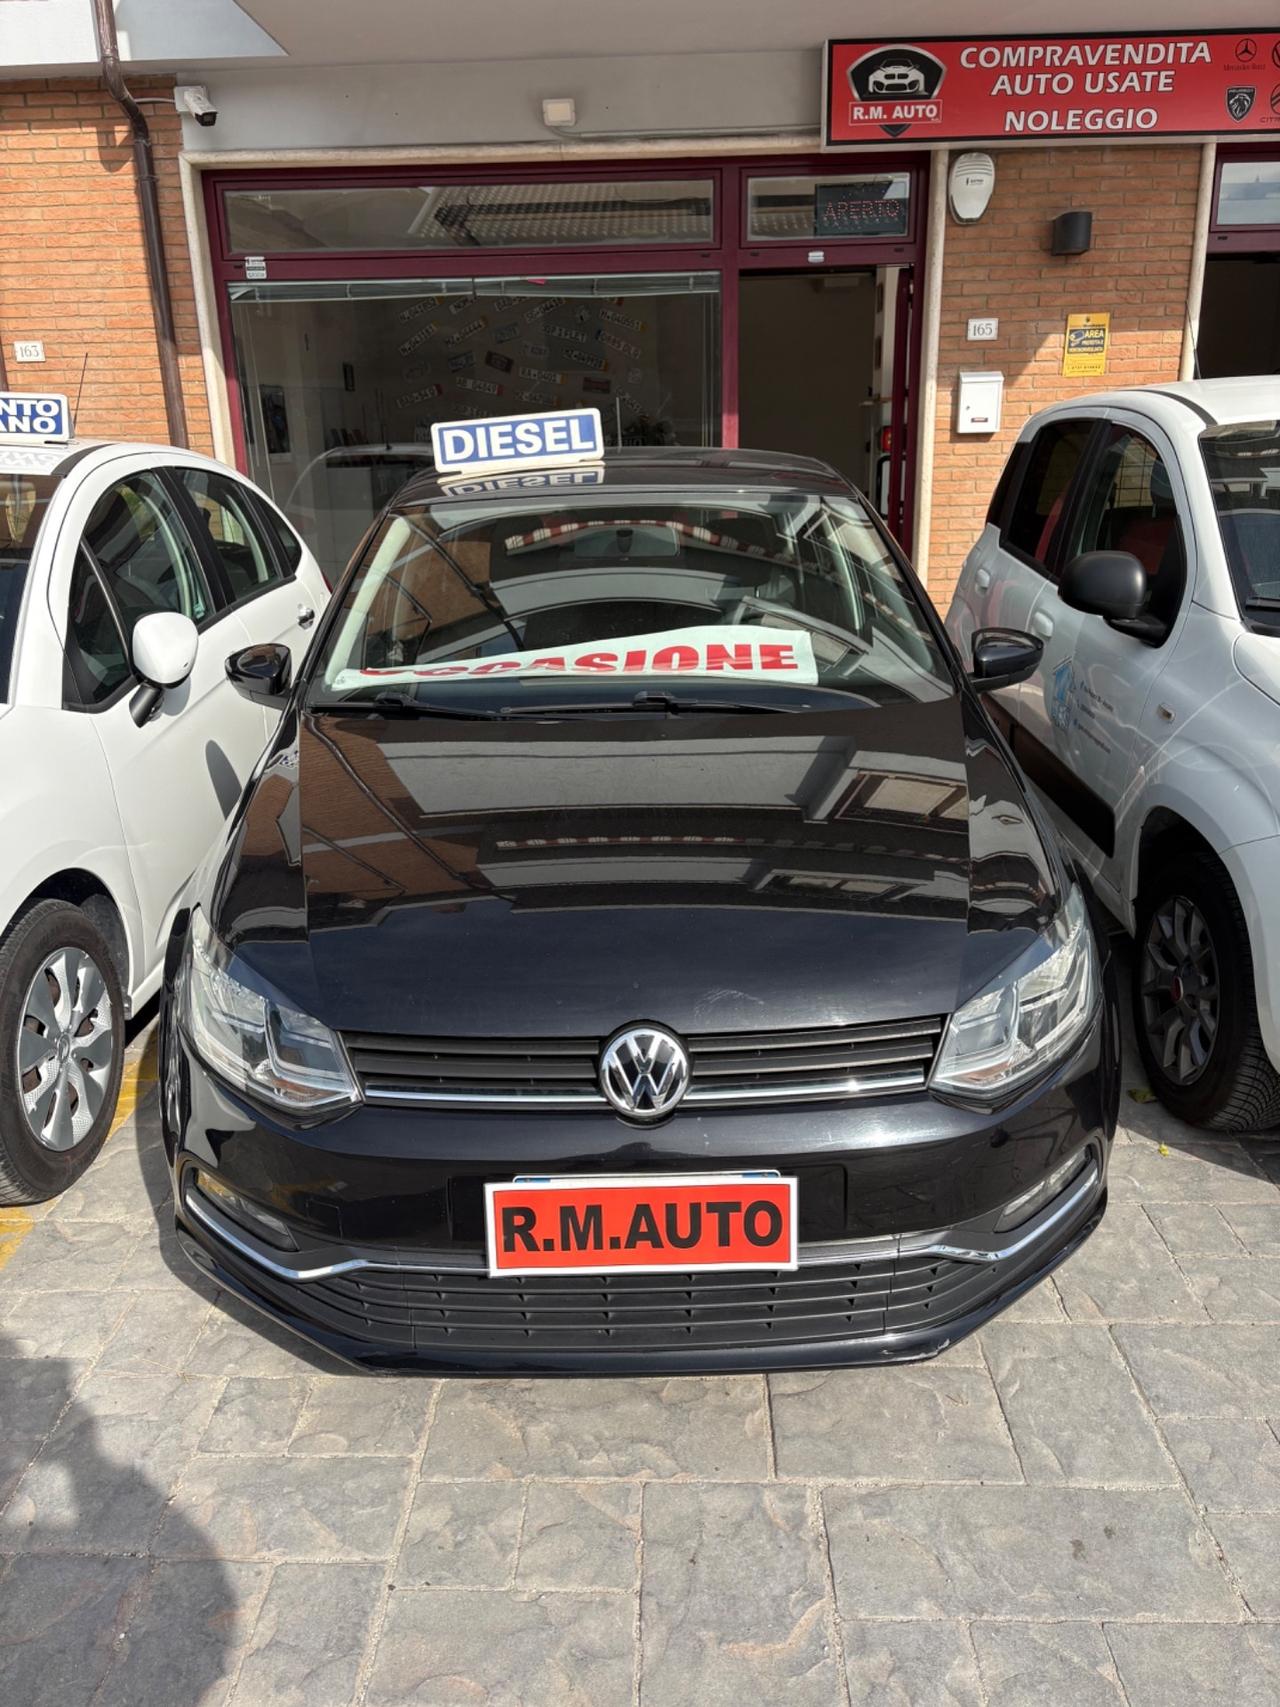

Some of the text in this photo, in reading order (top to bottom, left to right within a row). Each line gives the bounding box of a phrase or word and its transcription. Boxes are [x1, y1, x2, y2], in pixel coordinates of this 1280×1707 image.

[960, 41, 1212, 68] COMPRAVENDITA
[990, 70, 1176, 96] AUTO USATE
[853, 104, 938, 120] R.M. AUTO
[1004, 107, 1158, 132] NOLEGGIO
[823, 199, 900, 220] APERTO
[972, 322, 993, 337] 165
[1084, 329, 1104, 338] AREA
[19, 345, 40, 358] 163
[442, 418, 594, 462] DIESEL
[501, 1199, 783, 1253] R.M.AUTO
